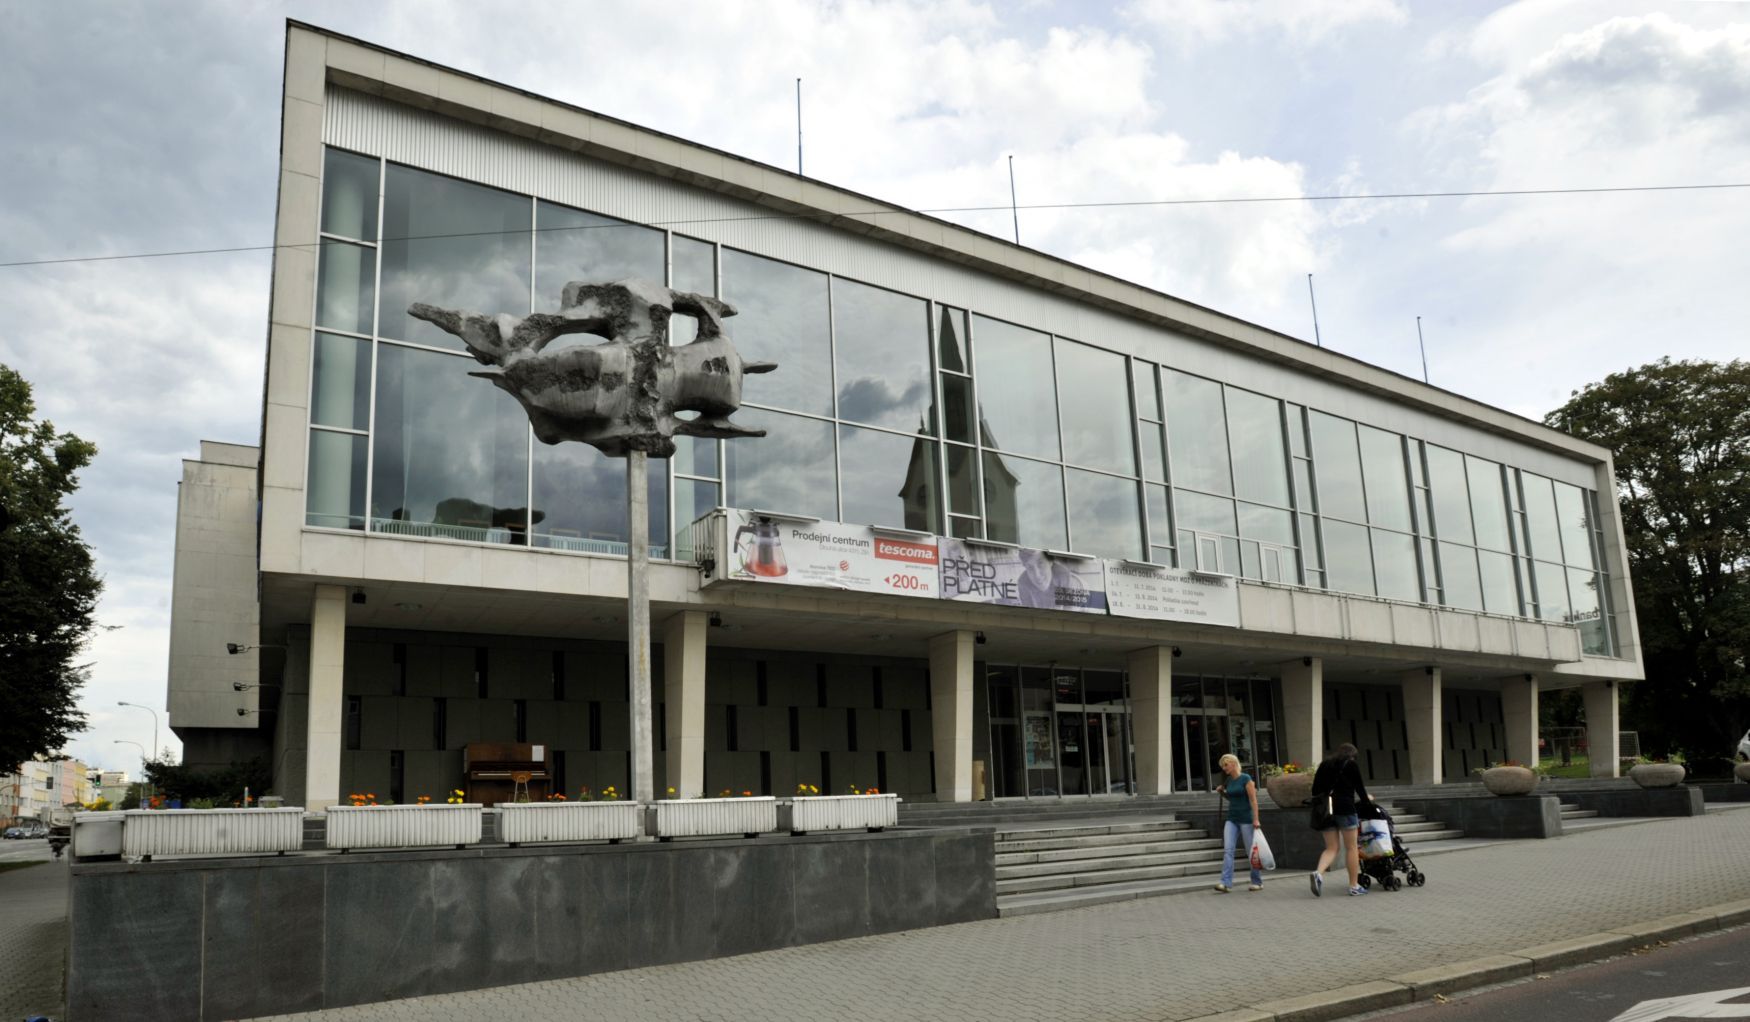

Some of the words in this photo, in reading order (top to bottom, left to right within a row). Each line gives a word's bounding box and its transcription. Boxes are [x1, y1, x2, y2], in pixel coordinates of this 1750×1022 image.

[792, 529, 830, 543] Prodejní
[832, 536, 870, 547] centrum
[942, 556, 996, 579] PŘED
[892, 573, 919, 589] 200
[943, 575, 1018, 599] PLATNÉ
